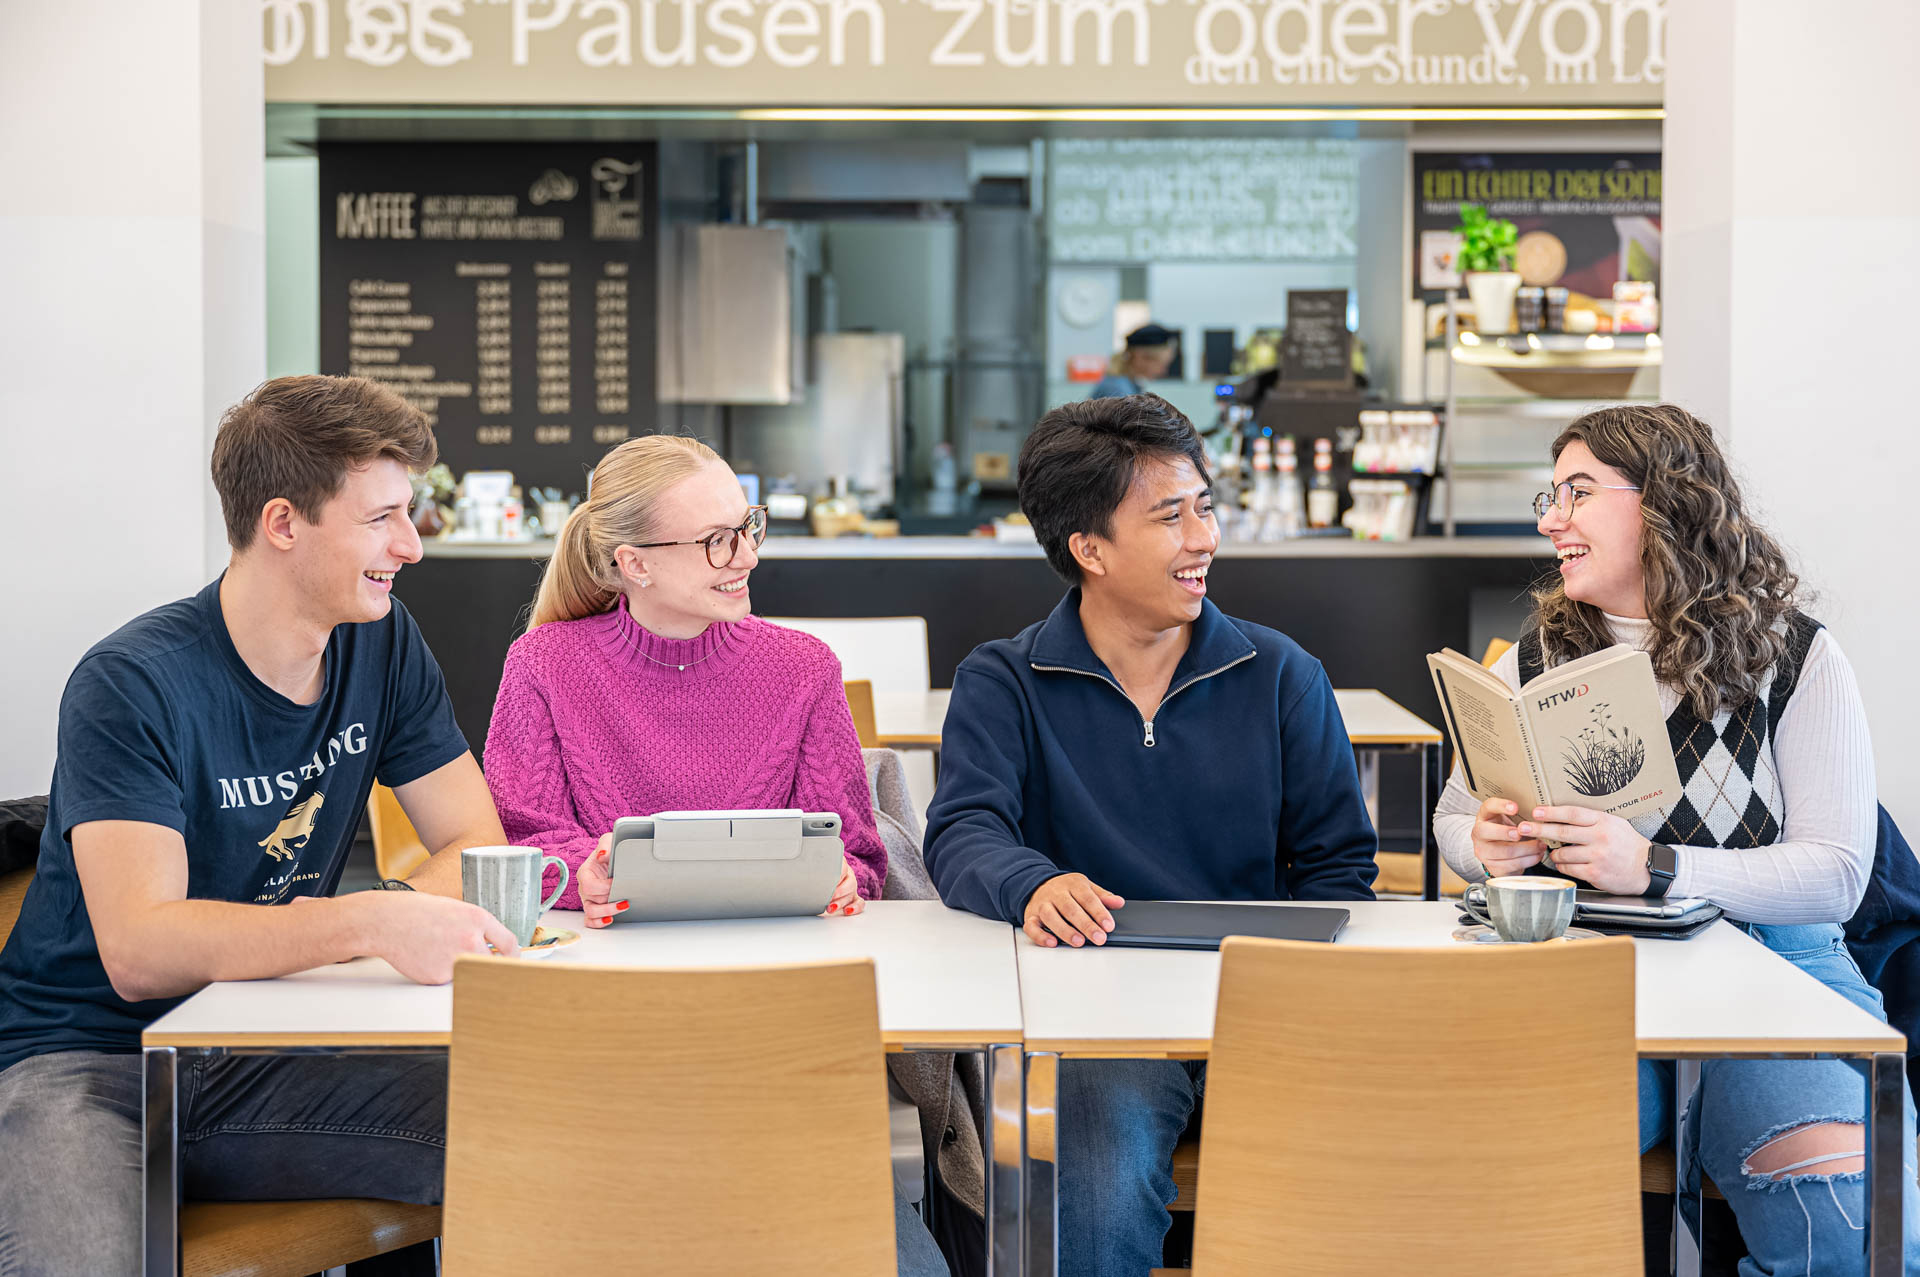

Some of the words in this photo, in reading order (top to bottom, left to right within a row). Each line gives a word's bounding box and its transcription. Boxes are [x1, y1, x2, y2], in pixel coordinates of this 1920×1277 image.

[511, 0, 885, 67] Pausen
[930, 0, 1149, 67] zum
[1194, 0, 1436, 67] oder
[1373, 43, 1531, 95] Stunde,
[336, 192, 416, 239] KAFFEE
[1538, 683, 1589, 711] HTWD
[218, 723, 367, 809] MUSTANG
[1618, 798, 1639, 810] YOUR
[1640, 789, 1663, 801] IDEAS
[292, 872, 320, 882] BRAND
